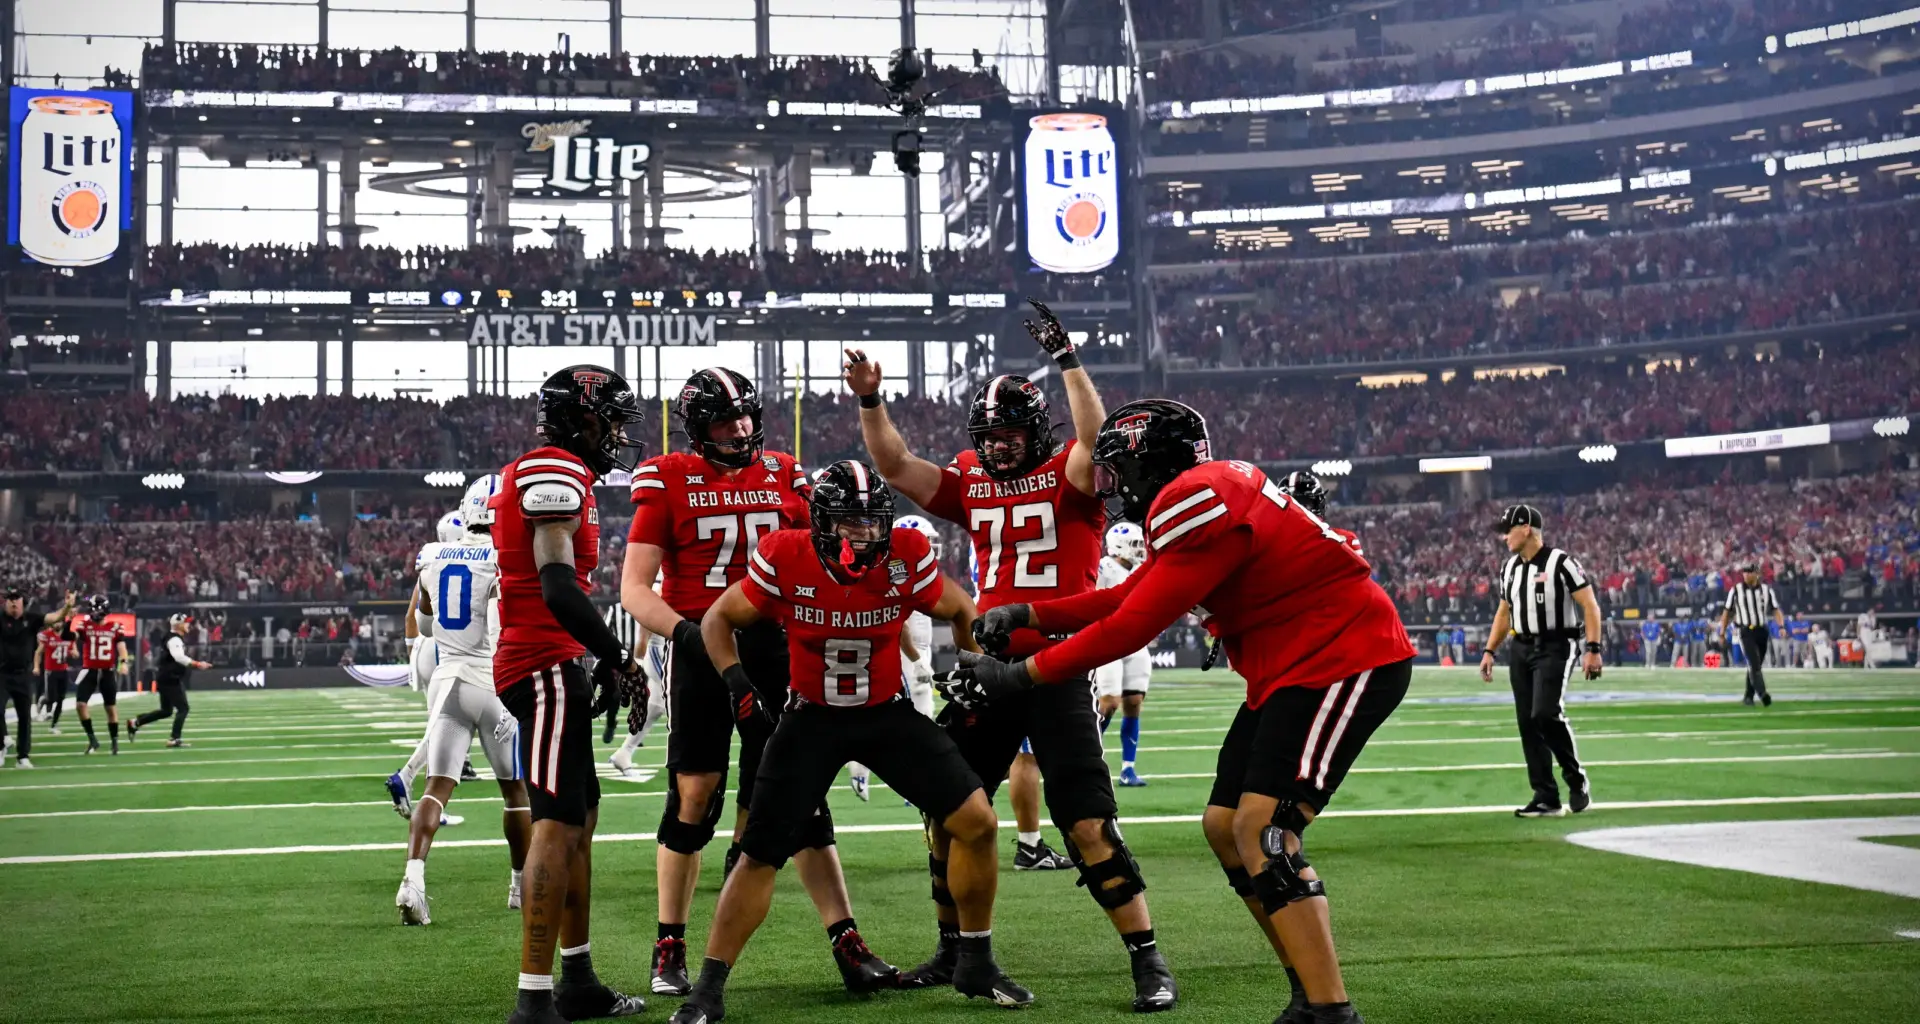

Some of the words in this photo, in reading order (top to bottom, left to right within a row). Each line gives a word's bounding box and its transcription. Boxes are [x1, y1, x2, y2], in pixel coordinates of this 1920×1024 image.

[42, 132, 115, 176] Lite
[546, 134, 650, 192] Lite
[1045, 148, 1110, 188] Lite
[471, 290, 482, 305] 7
[541, 290, 577, 307] 3:21
[706, 291, 724, 306] 13
[469, 314, 555, 346] AT&T
[564, 314, 717, 346] STADIUM
[686, 475, 704, 485] XII
[967, 482, 991, 499] RED
[995, 470, 1057, 498] RAIDERS
[688, 491, 718, 507] RED
[723, 490, 782, 506] RAIDERS
[435, 547, 491, 561] JOHNSON
[970, 501, 1058, 590] 72
[437, 563, 472, 631] 0
[795, 585, 815, 598] XII
[794, 604, 825, 625] RED
[831, 604, 902, 628] RAIDERS
[89, 636, 112, 660] 12
[824, 638, 871, 707] 8
